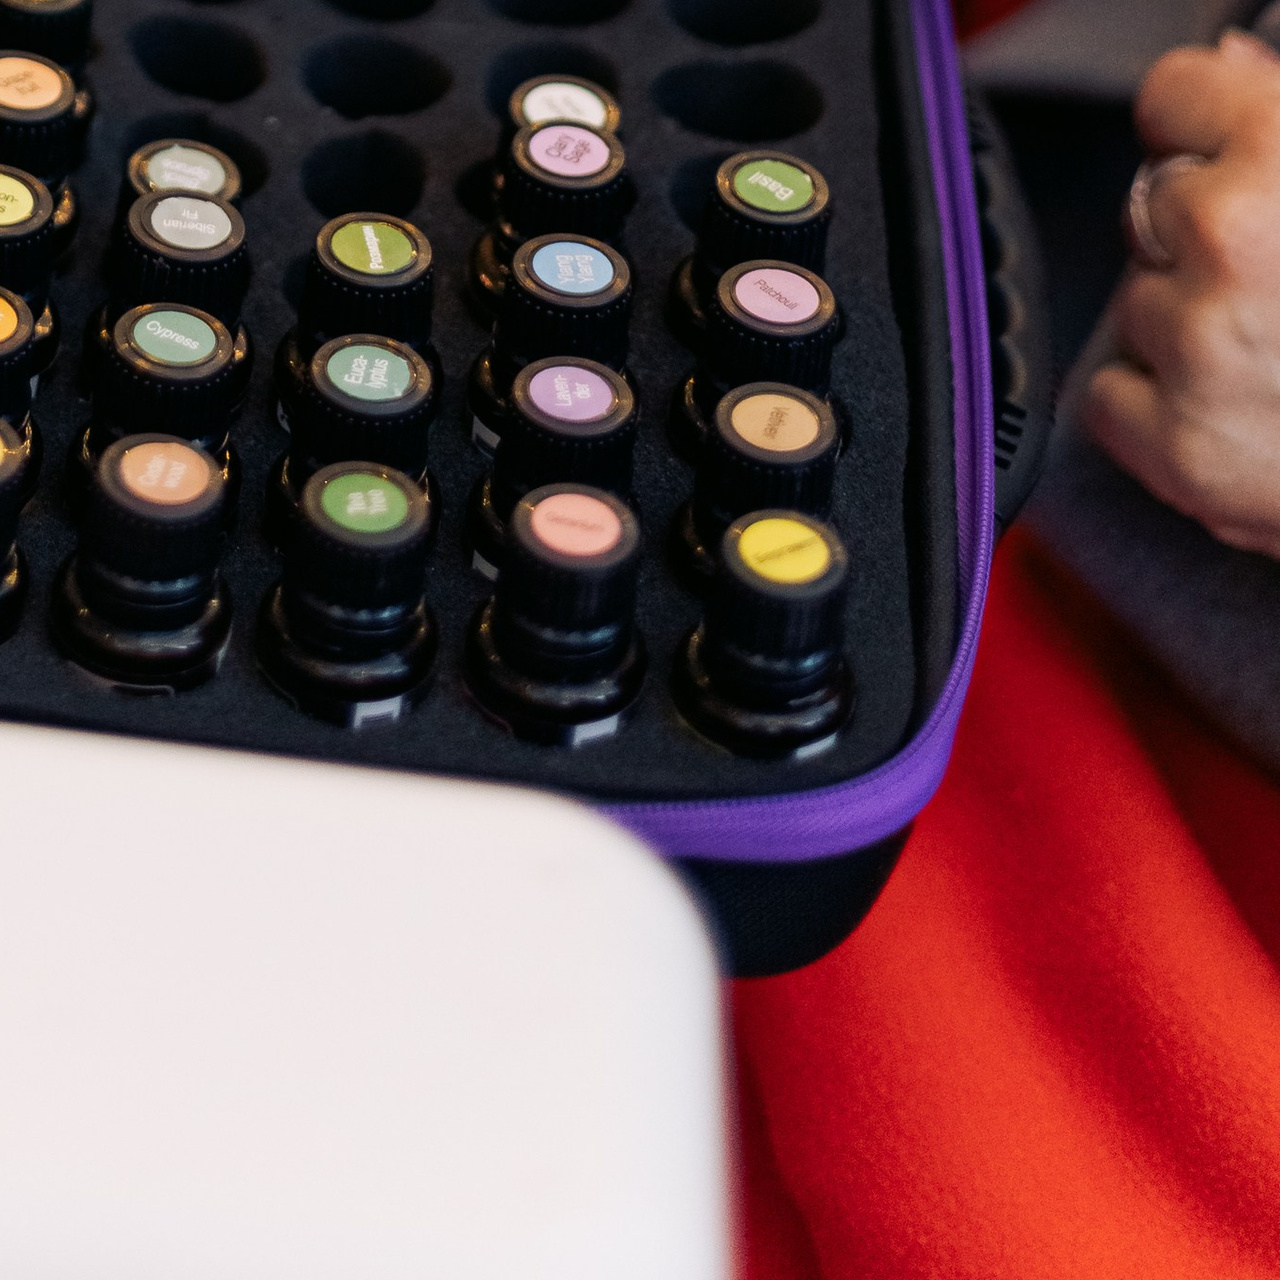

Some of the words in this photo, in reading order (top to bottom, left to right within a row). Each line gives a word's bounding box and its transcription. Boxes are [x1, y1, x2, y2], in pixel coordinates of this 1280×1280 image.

[748, 171, 795, 201] Basil
[163, 218, 216, 234] Siberian
[181, 208, 198, 220] Fir
[556, 254, 574, 284] Ylang
[576, 253, 595, 284] Ylang
[754, 279, 799, 311] Patchouli
[146, 320, 200, 350] Cypress
[344, 355, 368, 385] Euca-
[365, 358, 388, 389] lyptus
[554, 374, 572, 406] Laven-
[573, 382, 591, 400] der
